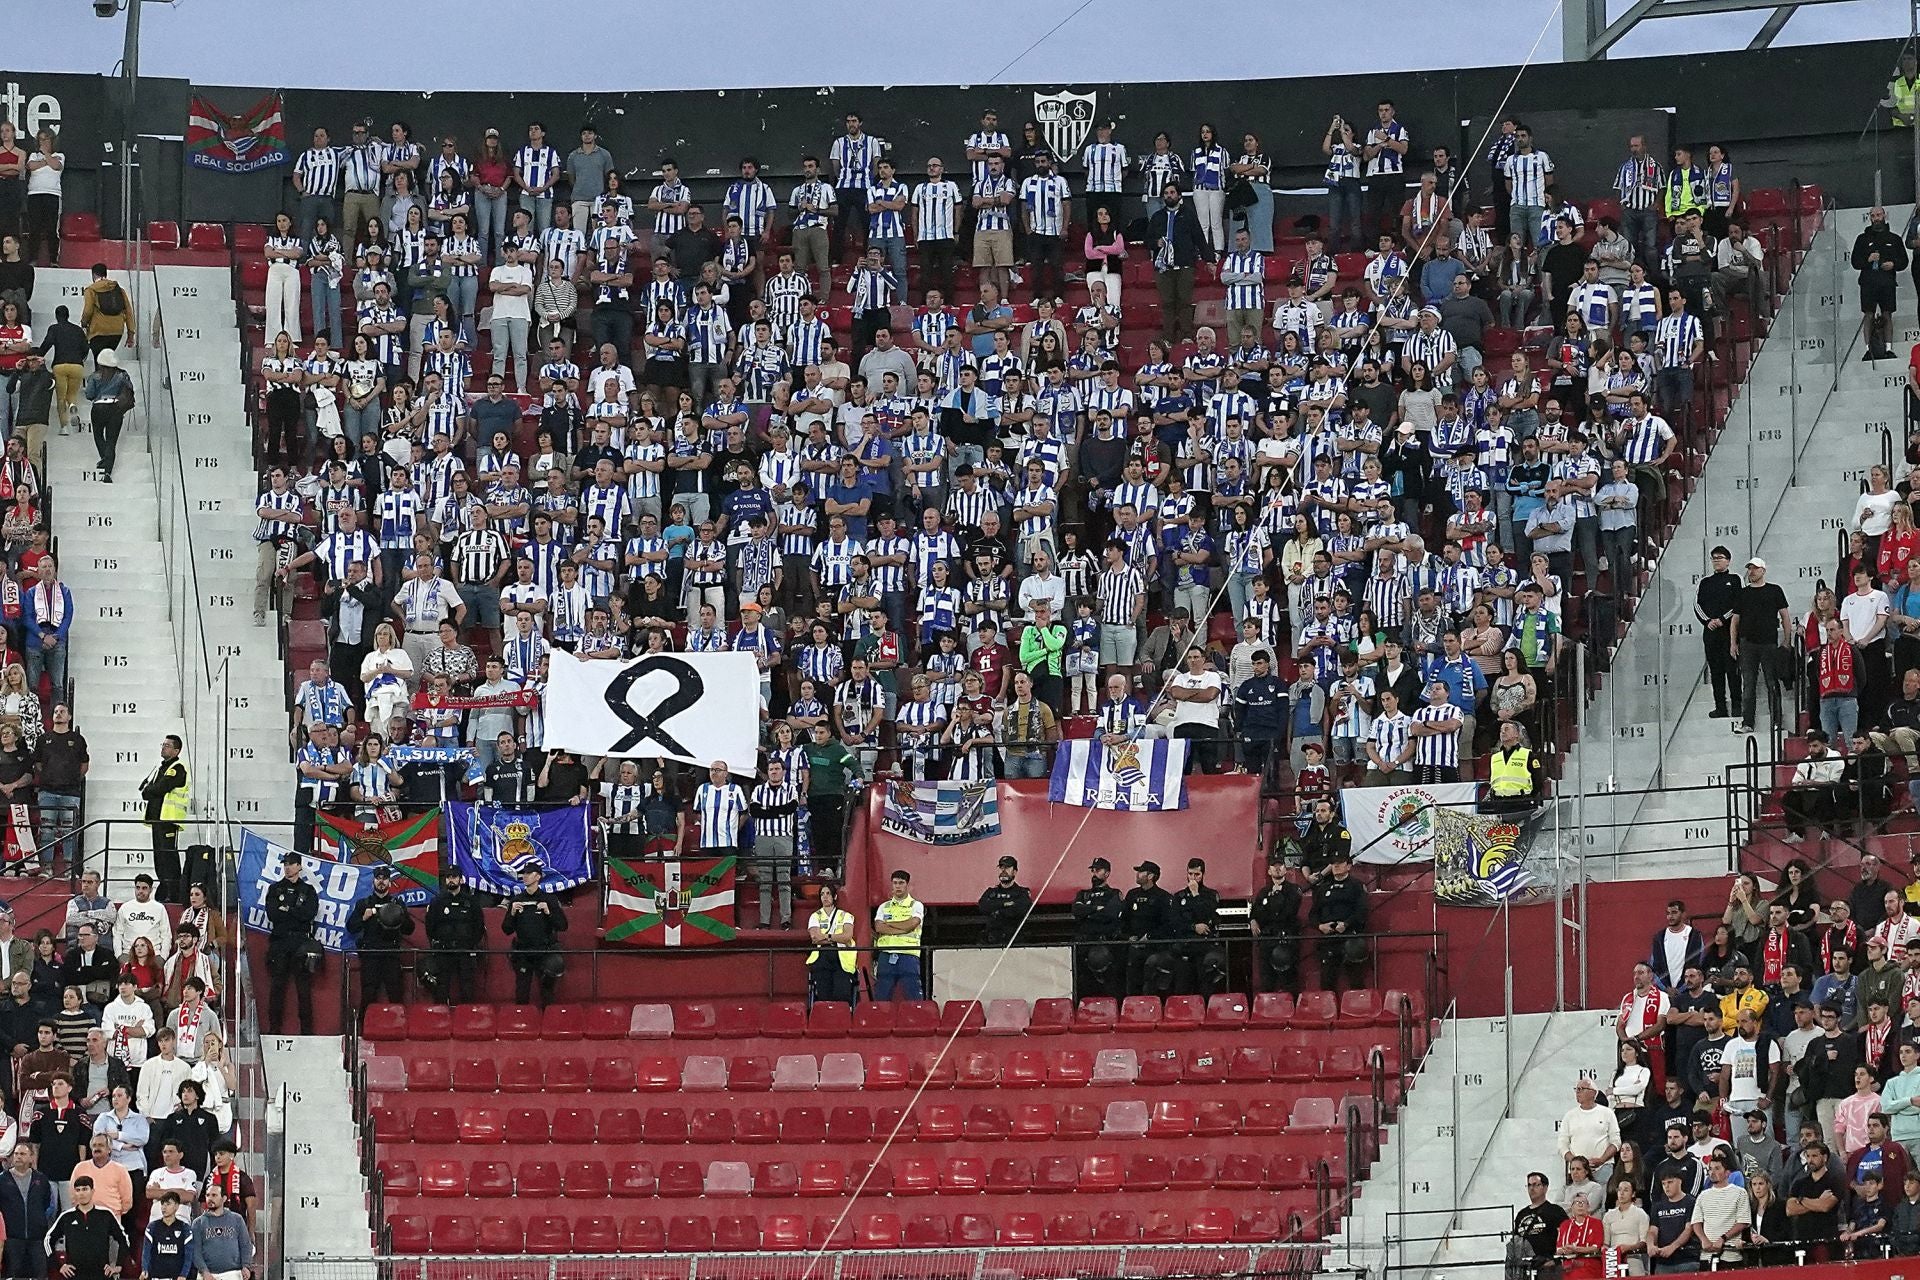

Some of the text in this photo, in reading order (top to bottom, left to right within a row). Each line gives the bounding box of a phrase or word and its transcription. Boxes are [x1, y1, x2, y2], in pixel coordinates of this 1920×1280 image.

[0, 83, 62, 141] te
[194, 152, 284, 172] REAL SOCIEDAD
[172, 286, 198, 297] F22
[176, 329, 200, 339] F21
[1800, 339, 1825, 349] F20
[179, 371, 205, 382] F20
[1884, 375, 1907, 387] F19
[187, 414, 212, 425] F19
[78, 422, 92, 433] F1
[1759, 430, 1782, 440] F18
[195, 457, 218, 468] F18
[199, 500, 221, 511] F17
[87, 516, 112, 527] F16
[1820, 518, 1844, 530] F16
[1715, 525, 1739, 536] F16
[210, 548, 234, 559] F16
[93, 558, 117, 569] F15
[1798, 566, 1822, 577] F15
[209, 596, 234, 607] F15
[99, 607, 123, 618] F14
[1668, 624, 1693, 635] F14
[216, 645, 241, 657] F14
[103, 655, 128, 667] F13
[111, 703, 137, 714] F12
[1620, 727, 1644, 738] F12
[115, 751, 138, 763] F11
[229, 748, 254, 759] F12
[412, 749, 448, 761] SUR
[1085, 788, 1161, 807] REALA
[1388, 788, 1412, 801] REAL
[236, 800, 259, 812] F11
[881, 816, 918, 839] AUPA
[1684, 828, 1709, 839] F10
[126, 853, 145, 864] F9
[128, 911, 156, 922] Silbon
[1600, 1015, 1617, 1027] F7
[275, 1039, 294, 1051] F7
[1464, 1074, 1482, 1085] F6
[1579, 1069, 1597, 1080] F6
[293, 1143, 312, 1155] F5
[1412, 1181, 1430, 1193] F4
[300, 1196, 320, 1209] F4
[1658, 1208, 1687, 1217] SILBON
